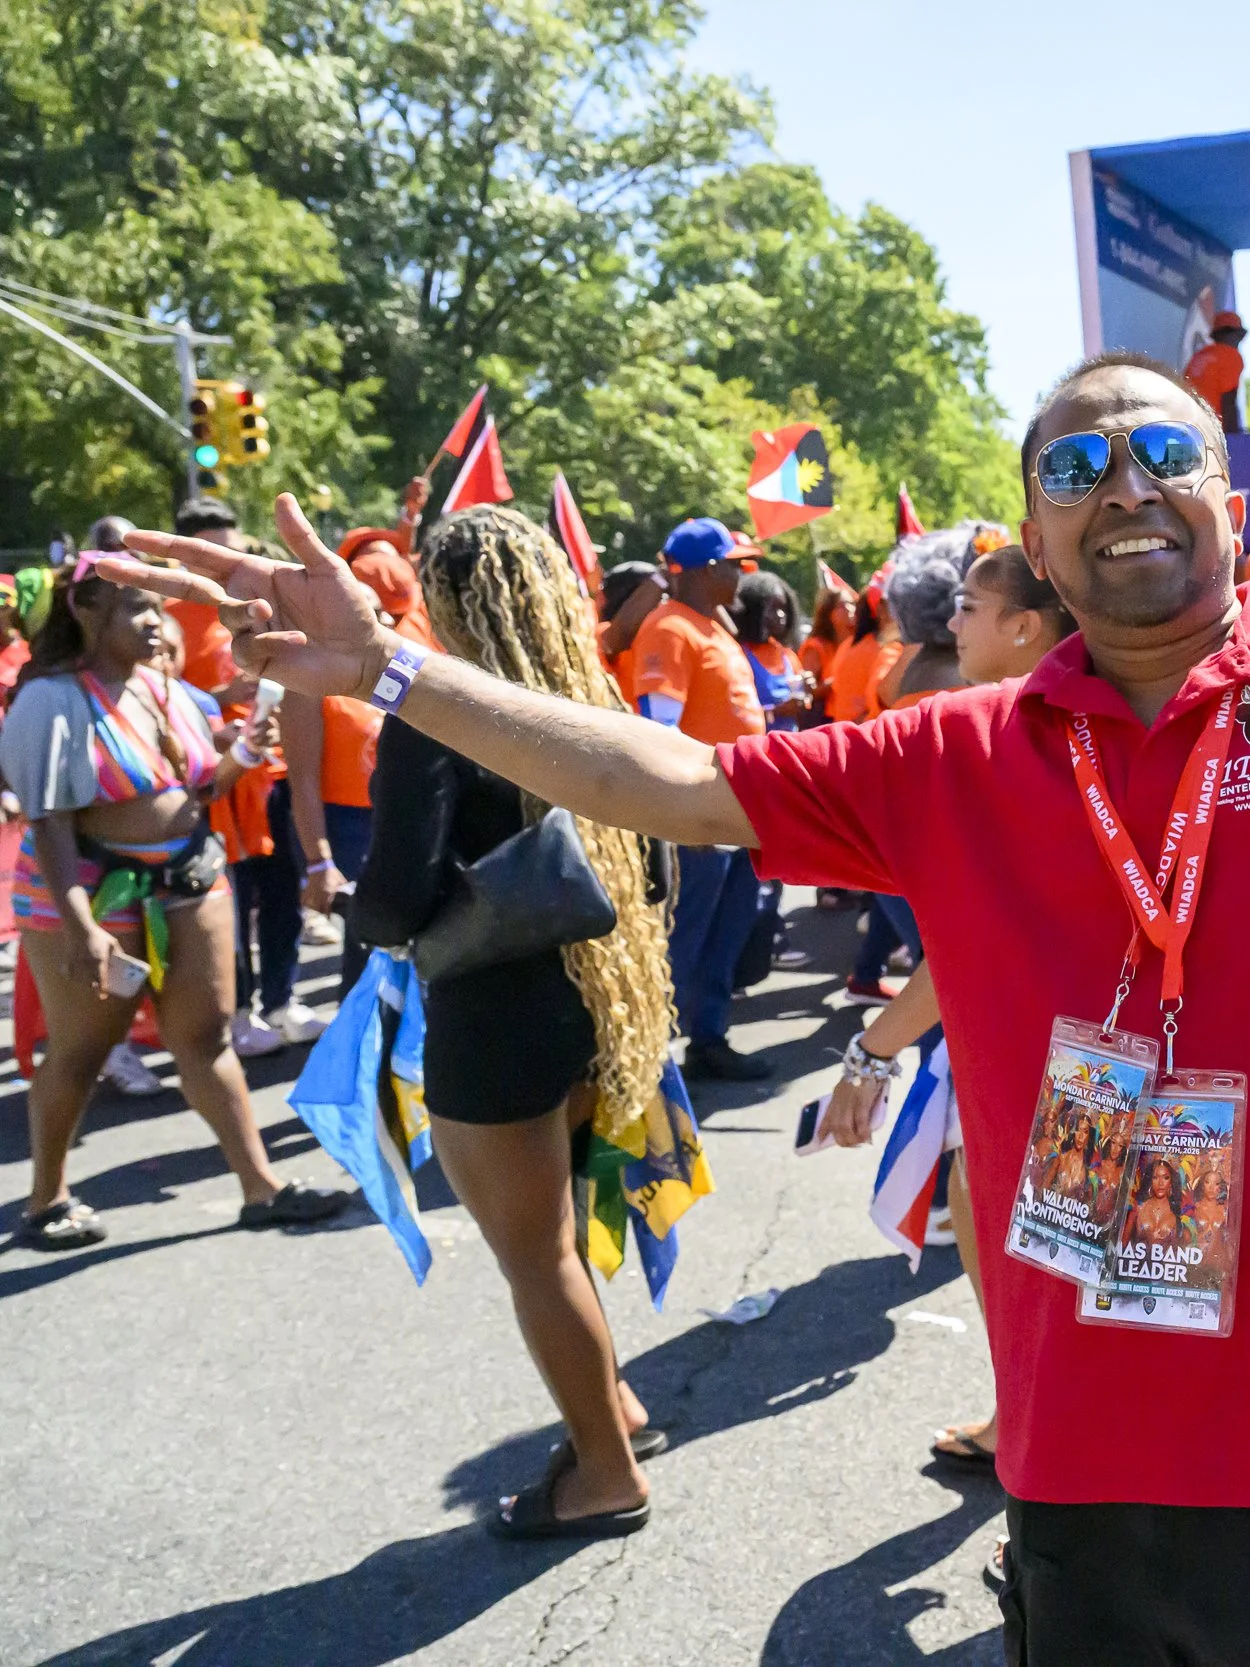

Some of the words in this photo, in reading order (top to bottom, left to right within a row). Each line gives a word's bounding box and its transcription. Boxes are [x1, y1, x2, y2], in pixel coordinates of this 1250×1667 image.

[1195, 757, 1220, 824] WIADCA
[1085, 783, 1119, 840] WIADCA
[1155, 812, 1189, 898] WIADC
[1122, 858, 1160, 922] WIADCA
[1175, 855, 1200, 924] WIADCA
[1053, 1080, 1089, 1100] MONDAY
[1089, 1092, 1131, 1113] CARNIVAL
[1065, 1094, 1091, 1109] SEPTEMBER
[1163, 1135, 1222, 1149] CARNIVAL
[1043, 1188, 1089, 1219] WALKING
[1151, 1243, 1203, 1265] BAND
[1118, 1259, 1188, 1283] LEADER
